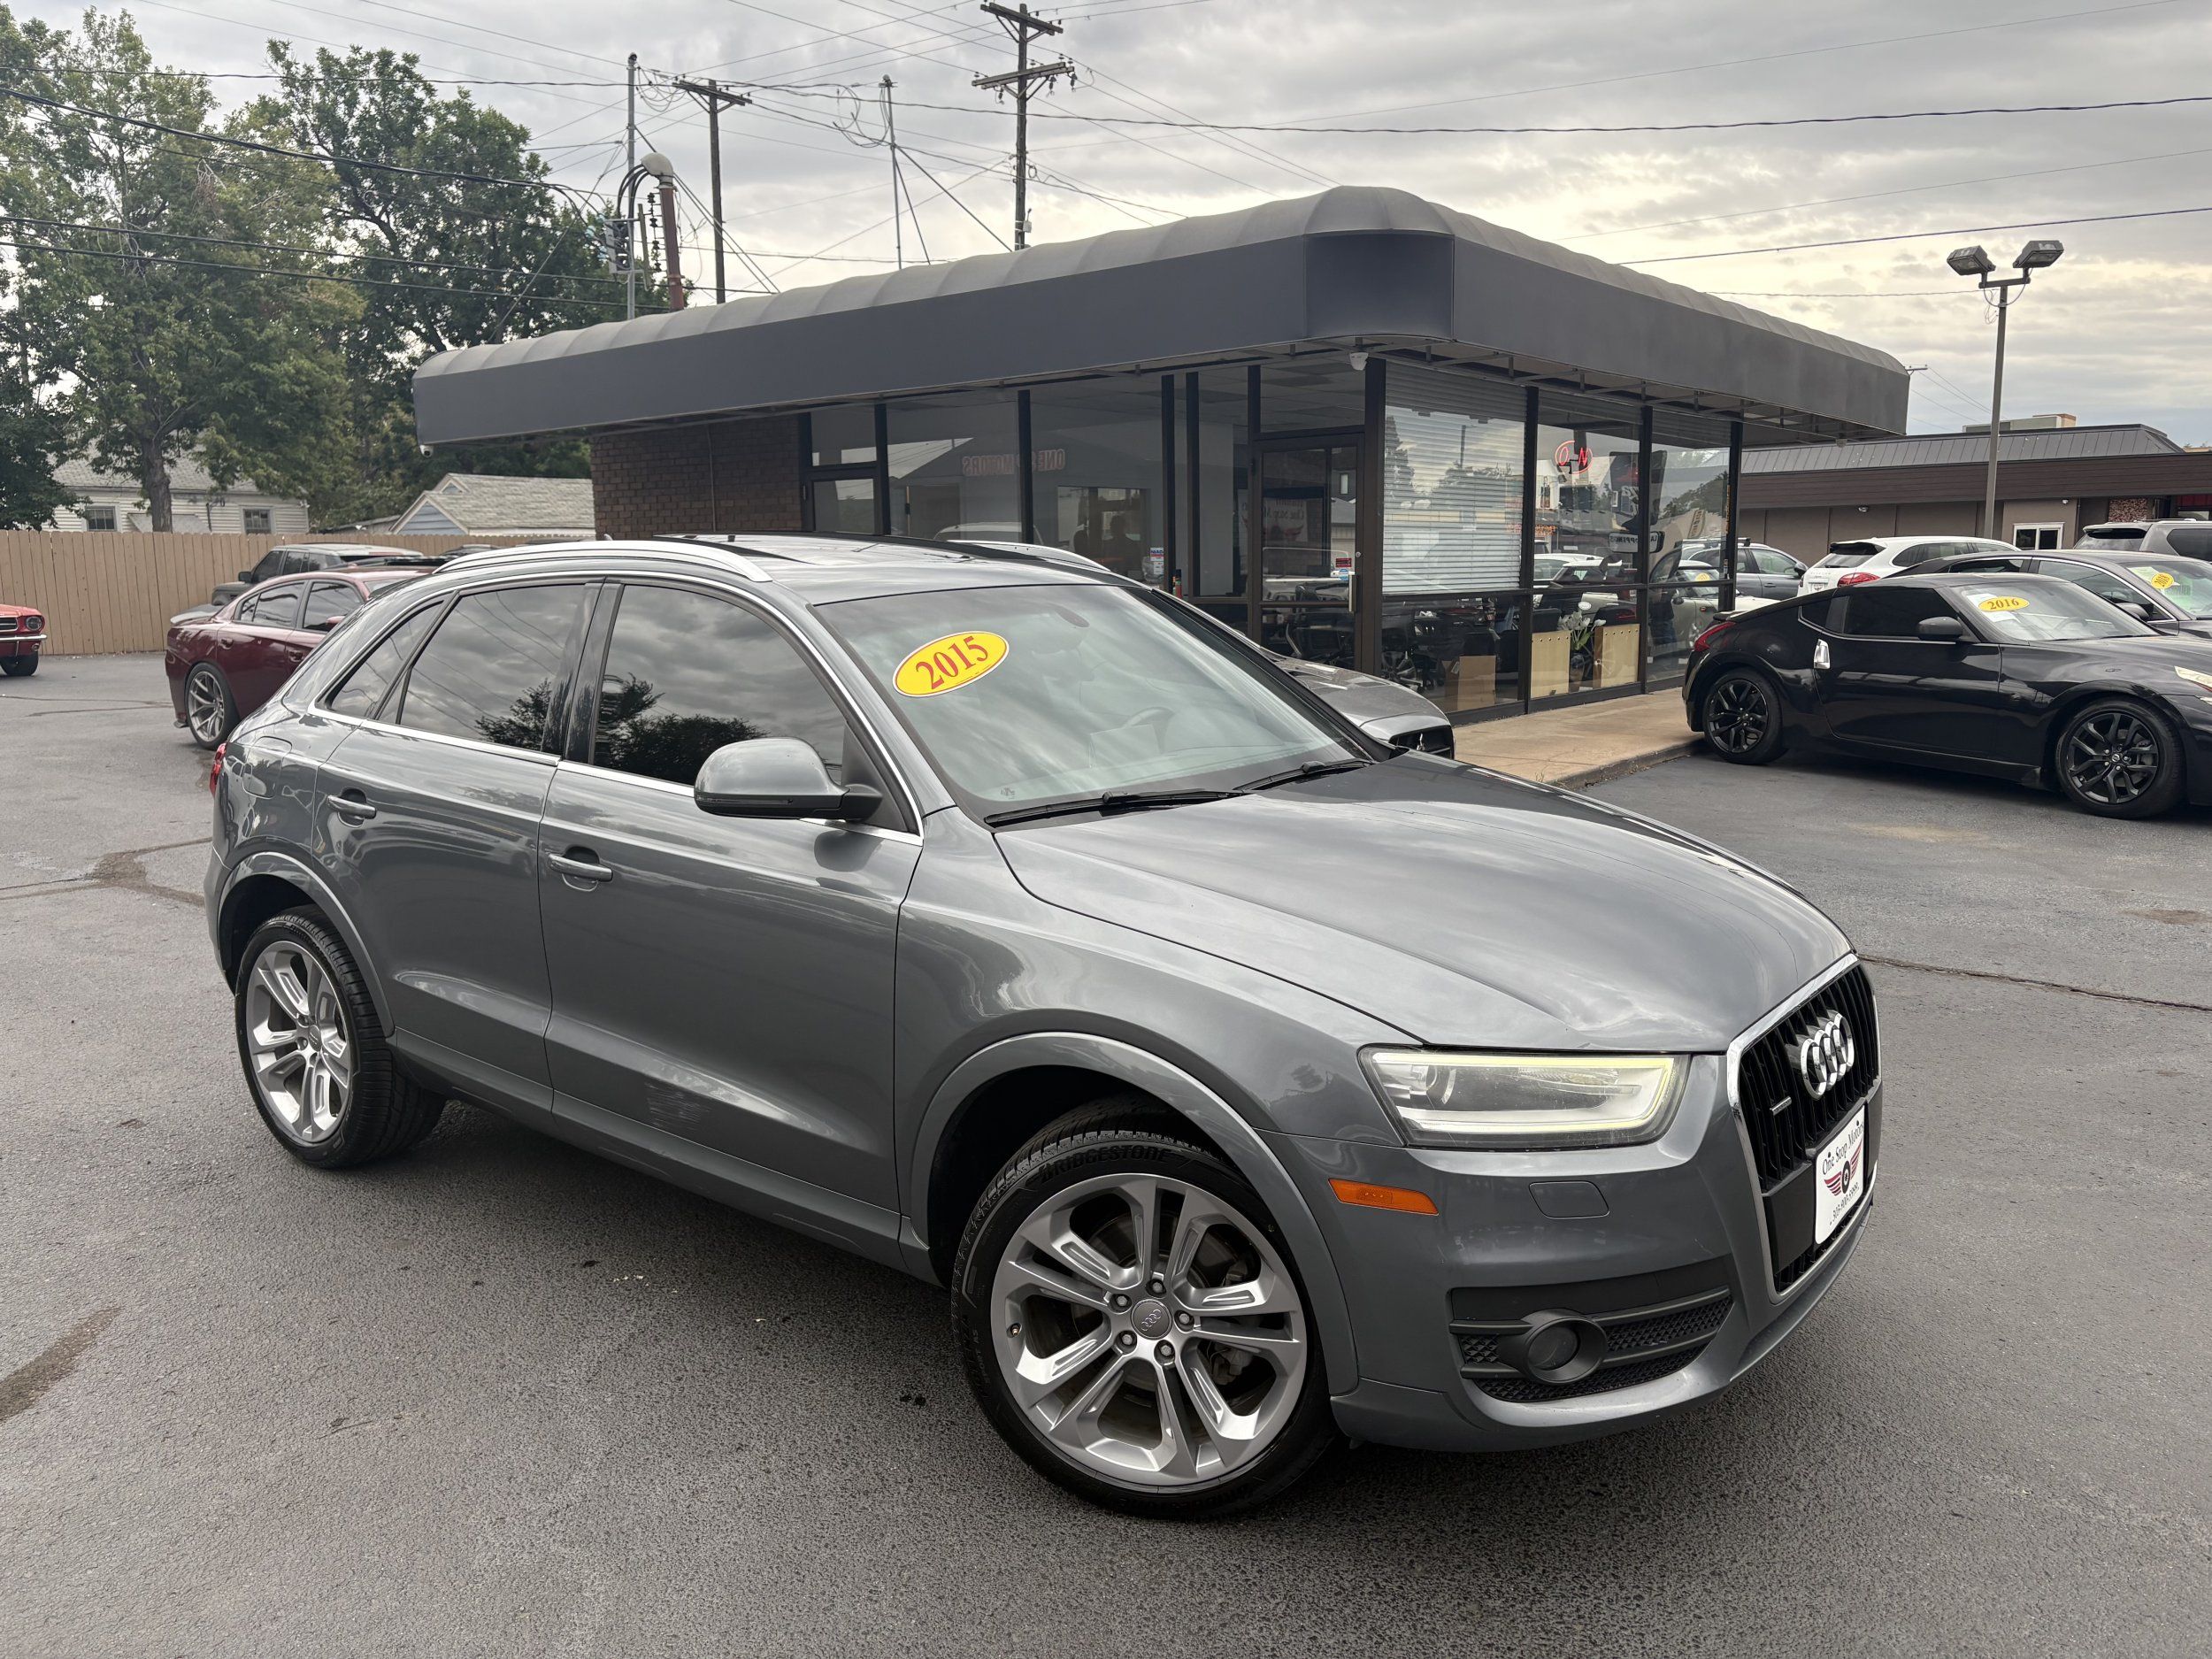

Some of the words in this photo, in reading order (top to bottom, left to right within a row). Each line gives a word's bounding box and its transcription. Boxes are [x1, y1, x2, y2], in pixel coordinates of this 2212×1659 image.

[1987, 598, 2019, 610] 2016
[915, 635, 988, 690] 2015
[1823, 1156, 1835, 1175] One
[1836, 1143, 1847, 1163] Stop
